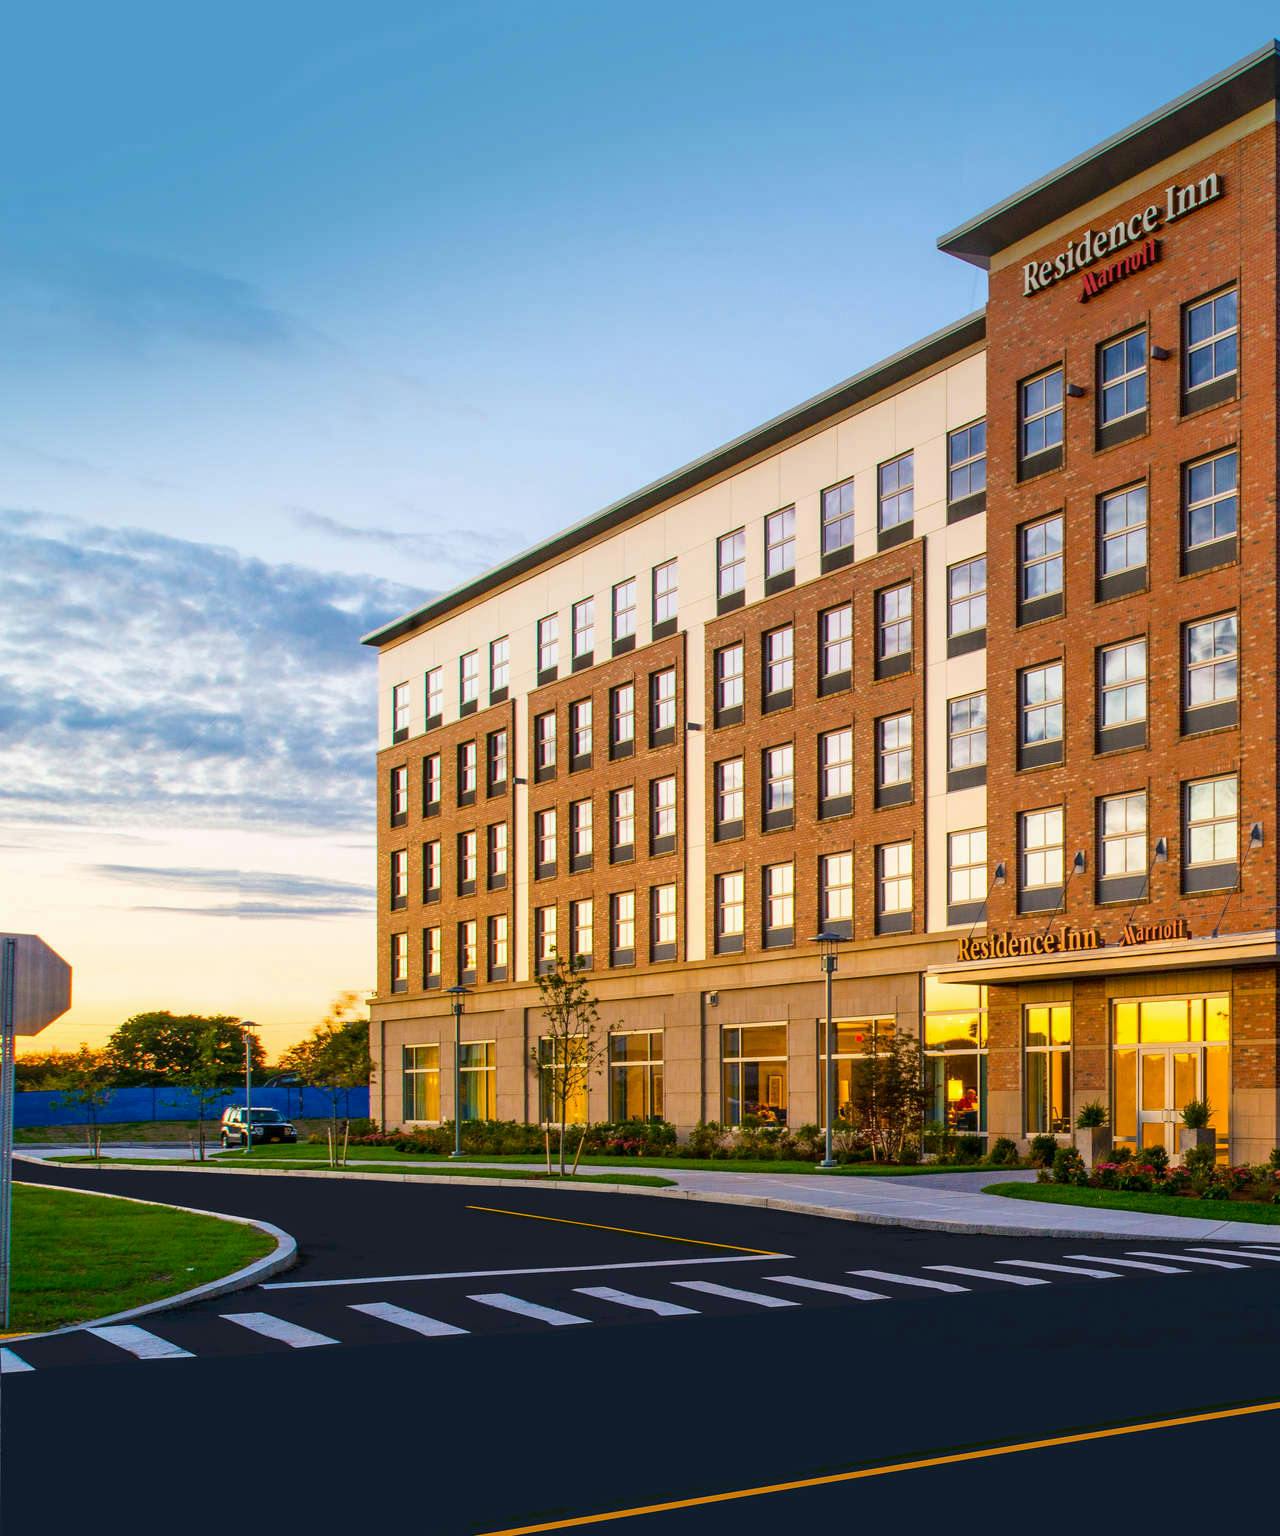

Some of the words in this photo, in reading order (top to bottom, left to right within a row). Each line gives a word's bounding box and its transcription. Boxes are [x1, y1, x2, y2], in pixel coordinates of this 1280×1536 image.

[1022, 204, 1158, 297] Residence
[1164, 172, 1221, 222] Inn
[1076, 239, 1157, 303] Marriott
[957, 931, 1055, 961] Residence
[1059, 926, 1098, 951] Inn
[1119, 919, 1185, 947] Marriott
